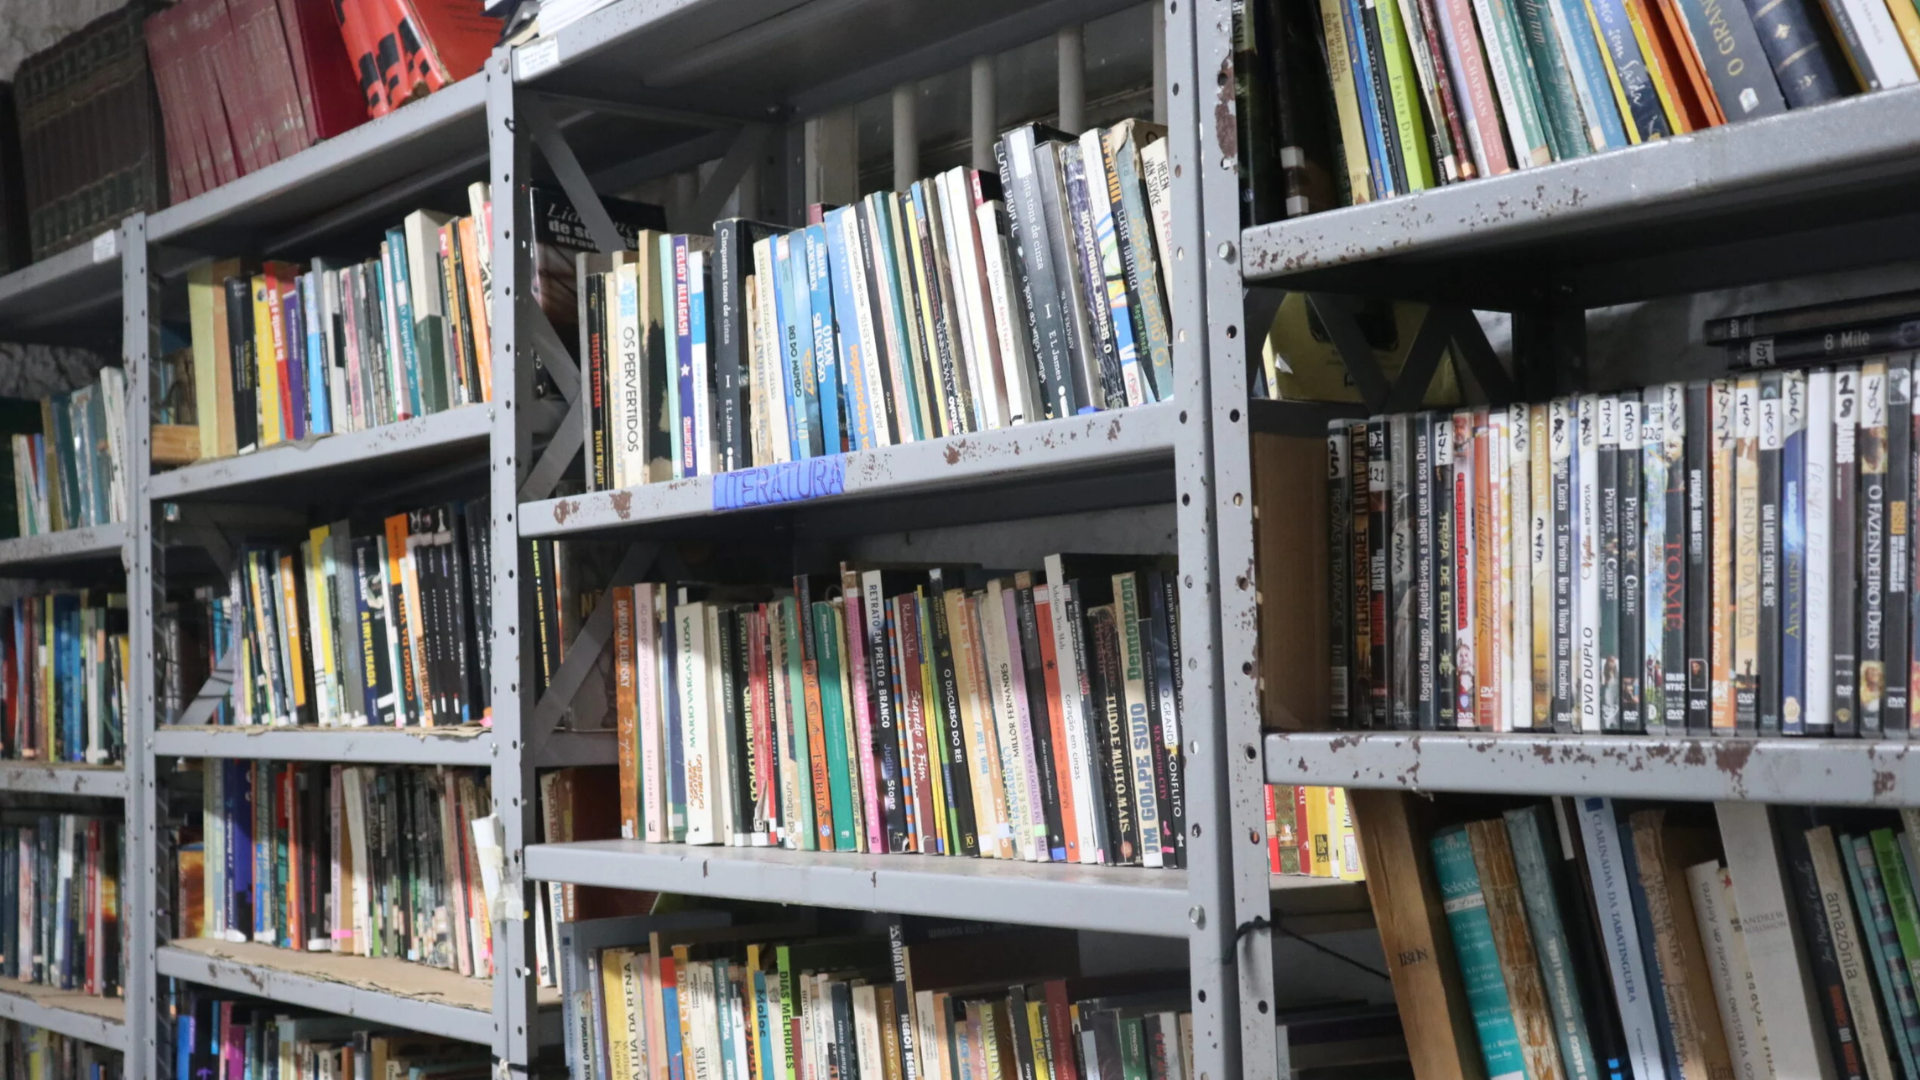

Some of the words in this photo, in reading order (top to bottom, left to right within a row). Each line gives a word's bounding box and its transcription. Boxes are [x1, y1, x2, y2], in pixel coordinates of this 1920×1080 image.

[1457, 20, 1472, 53] GARY
[1466, 55, 1488, 117] CHAPMAN
[1392, 75, 1408, 116] FRASER
[1400, 121, 1413, 153] DYER
[1145, 158, 1158, 178] VAN
[1157, 161, 1171, 190] HELEN
[1025, 200, 1035, 223] tons
[1030, 225, 1040, 238] de
[1080, 210, 1101, 287] EMBAIXADOR
[721, 229, 731, 279] Cinquenta
[1032, 241, 1045, 269] cinza
[678, 284, 689, 337] ALLAGASH
[722, 281, 730, 303] tons
[723, 305, 731, 317] de
[1094, 292, 1110, 339] SENHOR
[1133, 304, 1145, 331] Regina
[624, 326, 635, 349] OS
[723, 319, 732, 344] cinza
[787, 325, 797, 339] REI
[790, 342, 798, 357] DO
[812, 312, 826, 383] SILENCIOSO
[823, 334, 834, 366] DON
[1102, 343, 1112, 353] O
[1824, 334, 1833, 350] 8
[1841, 330, 1871, 348] Mile
[791, 360, 802, 397] MUNDO
[1052, 349, 1064, 380] James
[624, 353, 639, 453] PERVERTIDOS
[1417, 435, 1426, 460] Deus
[713, 455, 845, 511] LITERATURA
[1418, 462, 1427, 480] sou
[1419, 483, 1427, 496] eu
[1419, 498, 1429, 516] que
[1558, 484, 1569, 511] Costa
[1583, 484, 1591, 526] RESPOSTA
[1867, 484, 1882, 499] O
[1604, 488, 1616, 533] PIRATAS
[1624, 497, 1637, 546] PIRATAS
[1740, 487, 1755, 556] LENDAS
[1762, 504, 1775, 518] UM
[1418, 518, 1427, 546] sabei
[1558, 535, 1569, 572] Direitos
[1763, 555, 1775, 585] ENTRE
[1868, 503, 1882, 604] FAZENDEIRO
[1440, 565, 1450, 588] DE
[1557, 577, 1569, 595] Que
[1605, 557, 1617, 601] CARIBE
[1625, 574, 1638, 615] CARIBE
[1740, 564, 1755, 590] DA
[398, 593, 408, 625] VIDA
[618, 600, 629, 642] BARBARA
[869, 584, 881, 627] RETRATO
[1440, 592, 1450, 634] ELITE
[1742, 595, 1755, 638] VIDA
[400, 628, 409, 646] DA
[874, 631, 883, 644] EM
[1119, 577, 1143, 680] Demouzon
[1419, 629, 1430, 661] Magno
[1868, 610, 1881, 649] DEUS
[619, 645, 630, 687] DELINSKY
[875, 647, 886, 678] PRETO
[1582, 627, 1593, 679] DUPLO
[402, 648, 414, 700] CÓDIGO
[685, 656, 693, 704] VARGAS
[944, 669, 952, 677] O
[1001, 663, 1015, 719] FERNANDES
[1419, 663, 1431, 701] Rogerio
[1558, 660, 1569, 699] Recebeu
[879, 690, 891, 728] BRANCO
[945, 680, 959, 728] DISCURSO
[1162, 689, 1171, 698] O
[1583, 685, 1593, 715] DVD
[688, 706, 696, 747] MARIO
[911, 691, 923, 738] Segredo
[1064, 693, 1077, 732] coração
[1105, 694, 1120, 735] TUDO
[1130, 702, 1148, 749] SUJO
[1163, 702, 1175, 747] GRANDE
[951, 731, 960, 746] DO
[954, 748, 963, 763] REI
[1008, 721, 1020, 757] MILLÔR
[1069, 735, 1077, 749] em
[1112, 737, 1120, 746] E
[883, 744, 895, 777] Judith
[1071, 752, 1081, 780] cinzas
[1111, 749, 1125, 796] MUITO
[1153, 725, 1162, 742] SEX
[1158, 778, 1168, 800] CITY
[886, 780, 898, 810] Stone
[1135, 755, 1155, 821] GOLPE
[1168, 754, 1183, 817] CONFLITO
[1117, 798, 1130, 834] MAIS
[1591, 814, 1614, 889] CLARINADAS
[1606, 892, 1618, 910] DA
[1826, 892, 1859, 979] amazônia
[891, 941, 906, 982] AVATAR
[1611, 912, 1637, 1003] TABATINGUERA
[779, 971, 789, 998] DIAS
[781, 1003, 794, 1069] MELHORES
